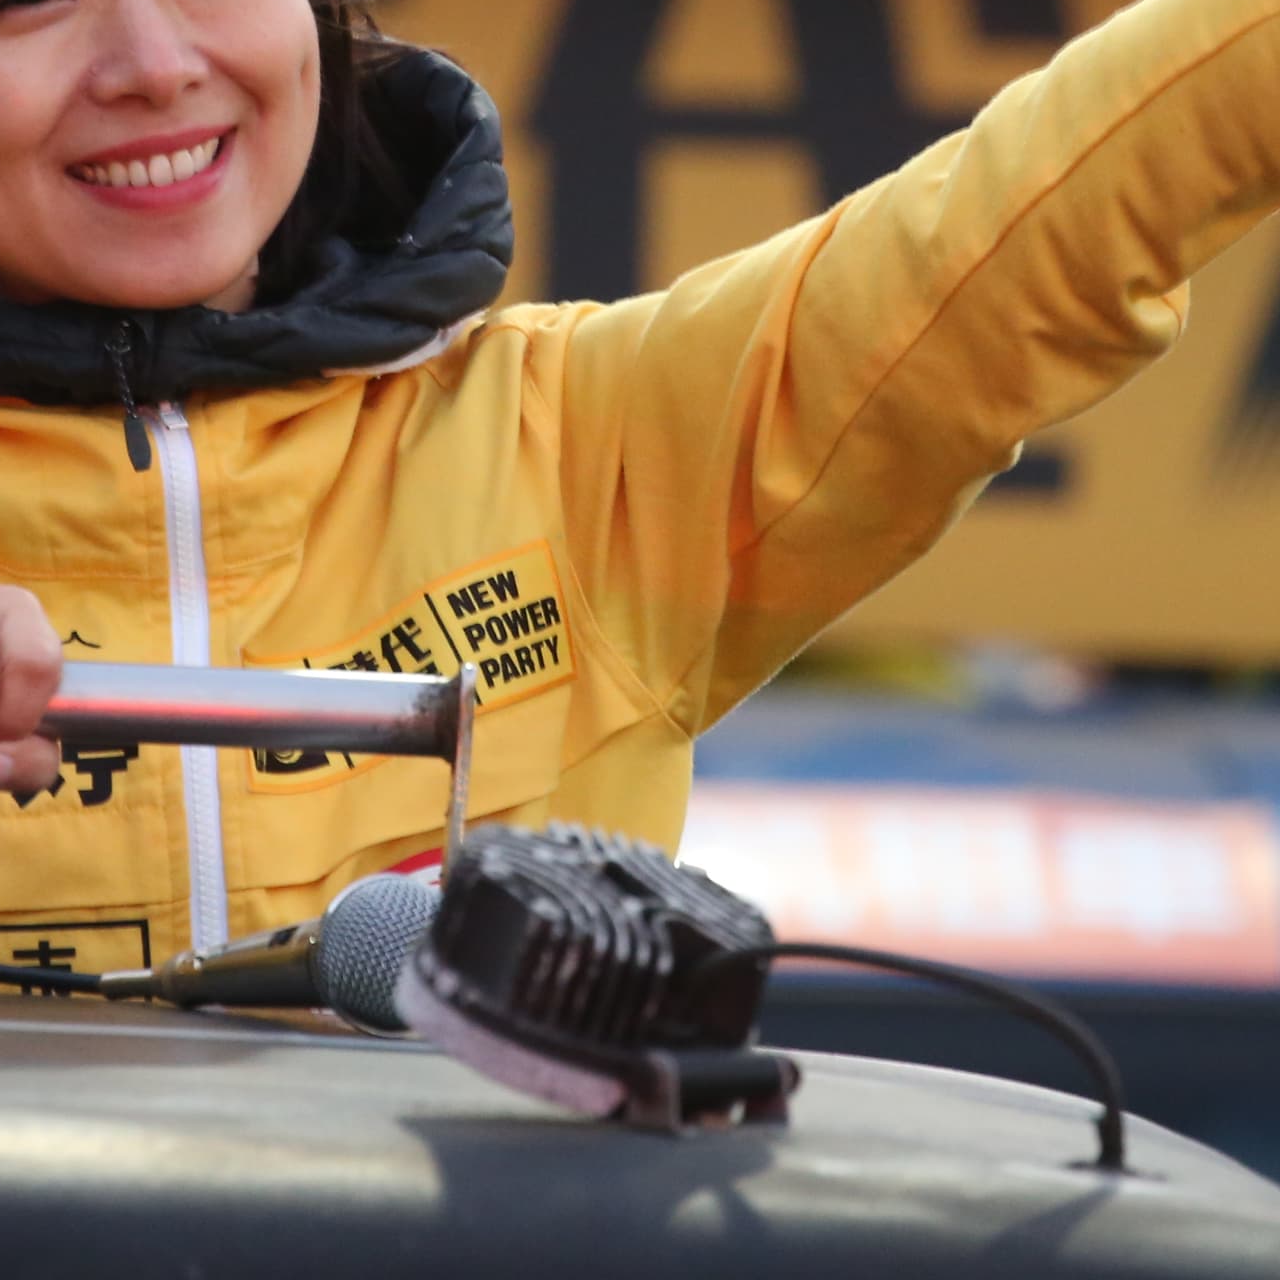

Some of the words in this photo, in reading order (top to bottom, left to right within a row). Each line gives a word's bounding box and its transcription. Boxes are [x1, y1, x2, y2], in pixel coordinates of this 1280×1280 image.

[446, 570, 520, 619] NEW
[463, 595, 561, 652] POWER
[480, 636, 560, 688] PARTY
